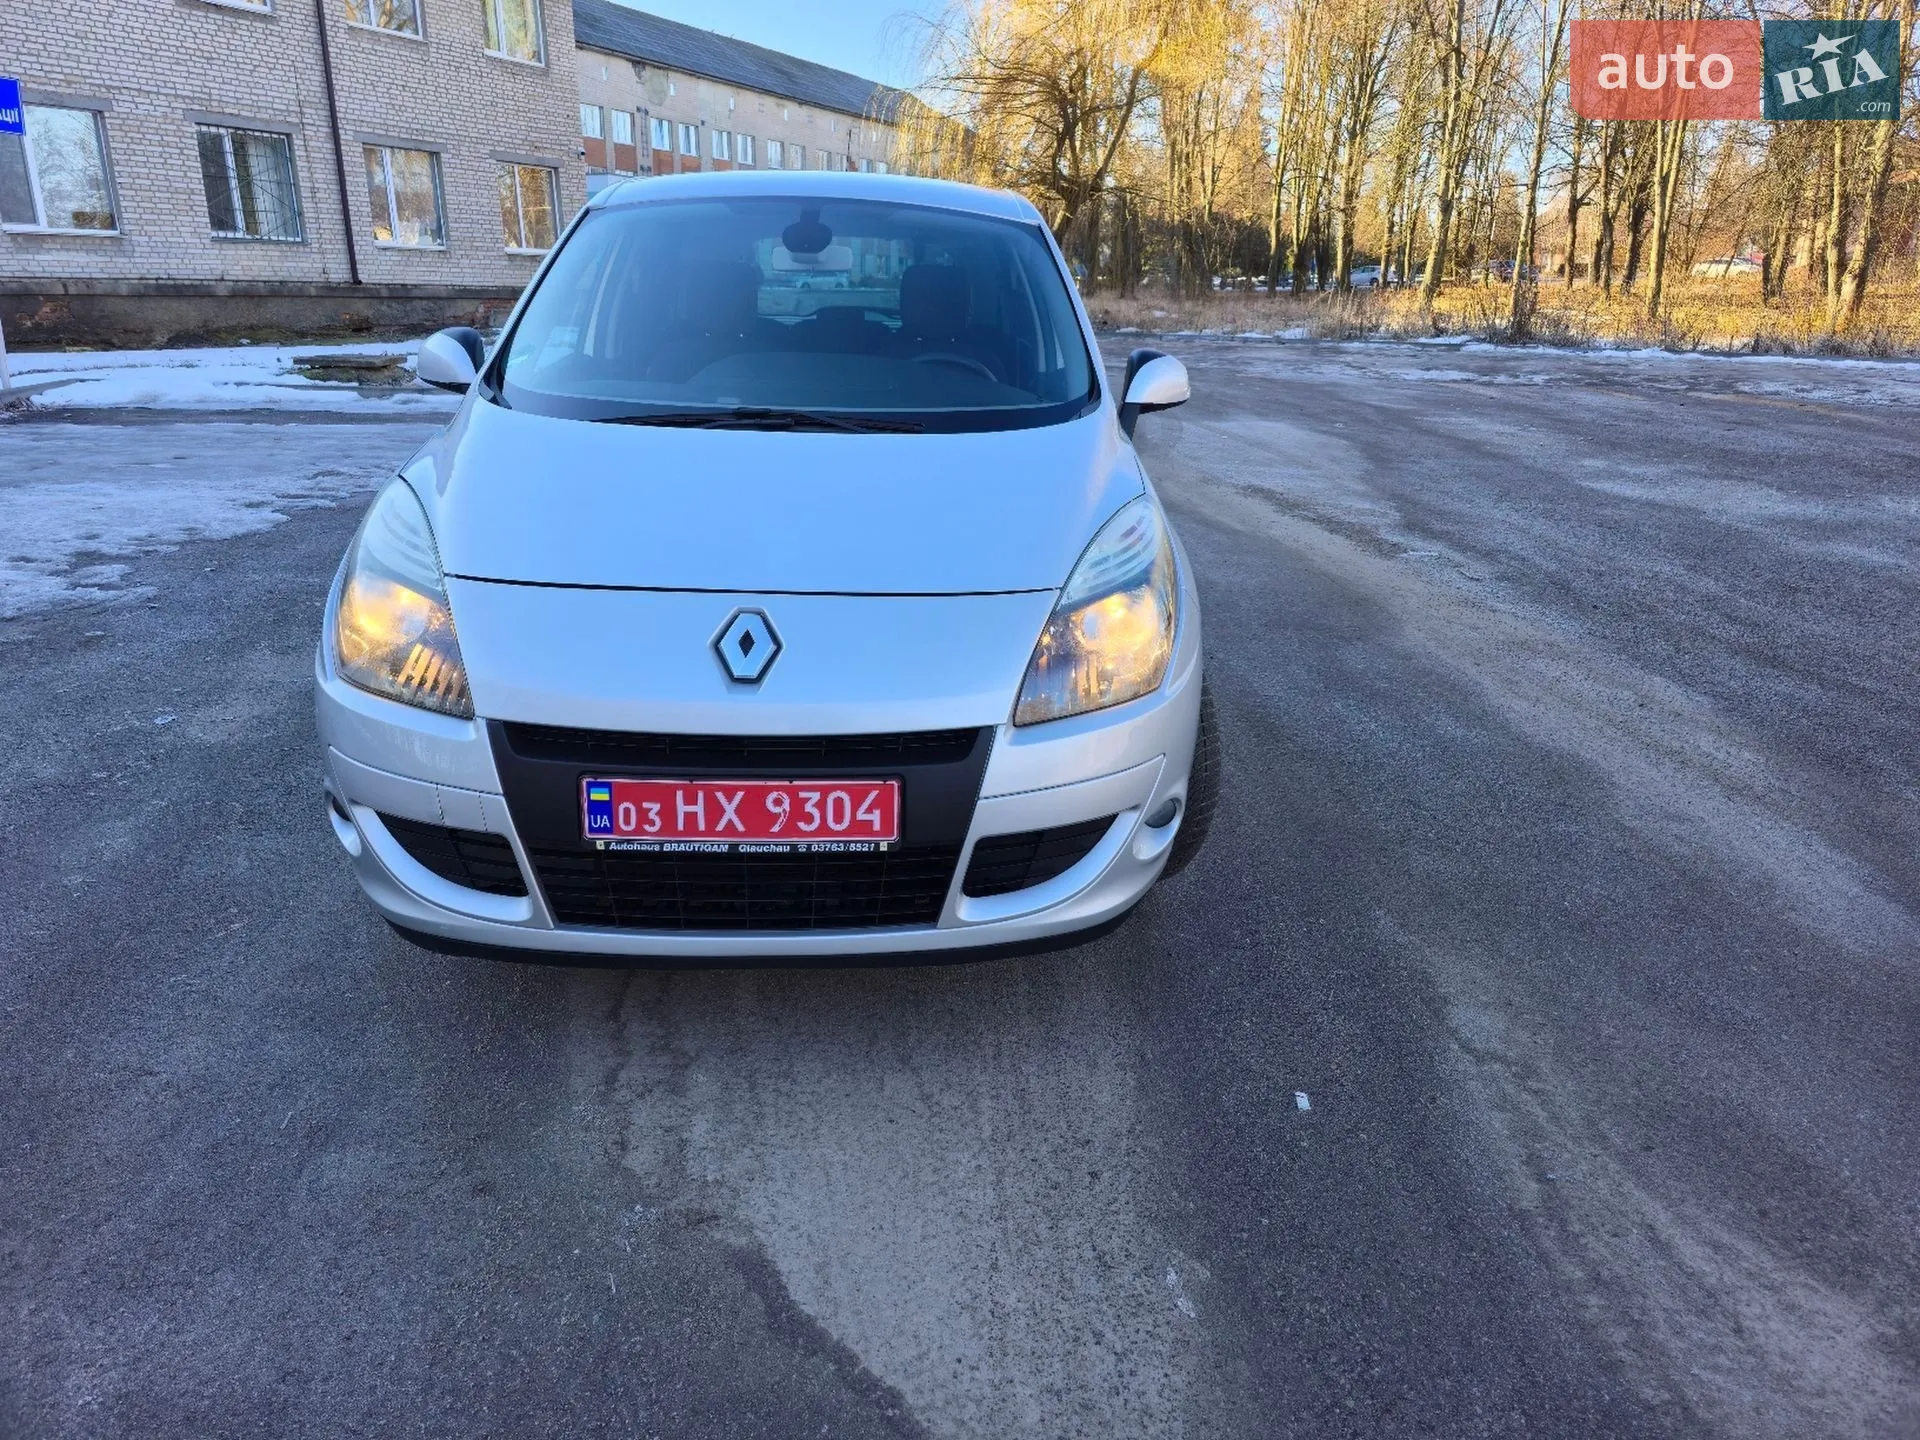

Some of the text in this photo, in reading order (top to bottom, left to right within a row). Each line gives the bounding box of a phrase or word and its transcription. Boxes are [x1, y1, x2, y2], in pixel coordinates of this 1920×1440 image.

[618, 790, 881, 832] 03 HX 9304
[591, 815, 611, 828] UA
[609, 842, 660, 851] Autohaus
